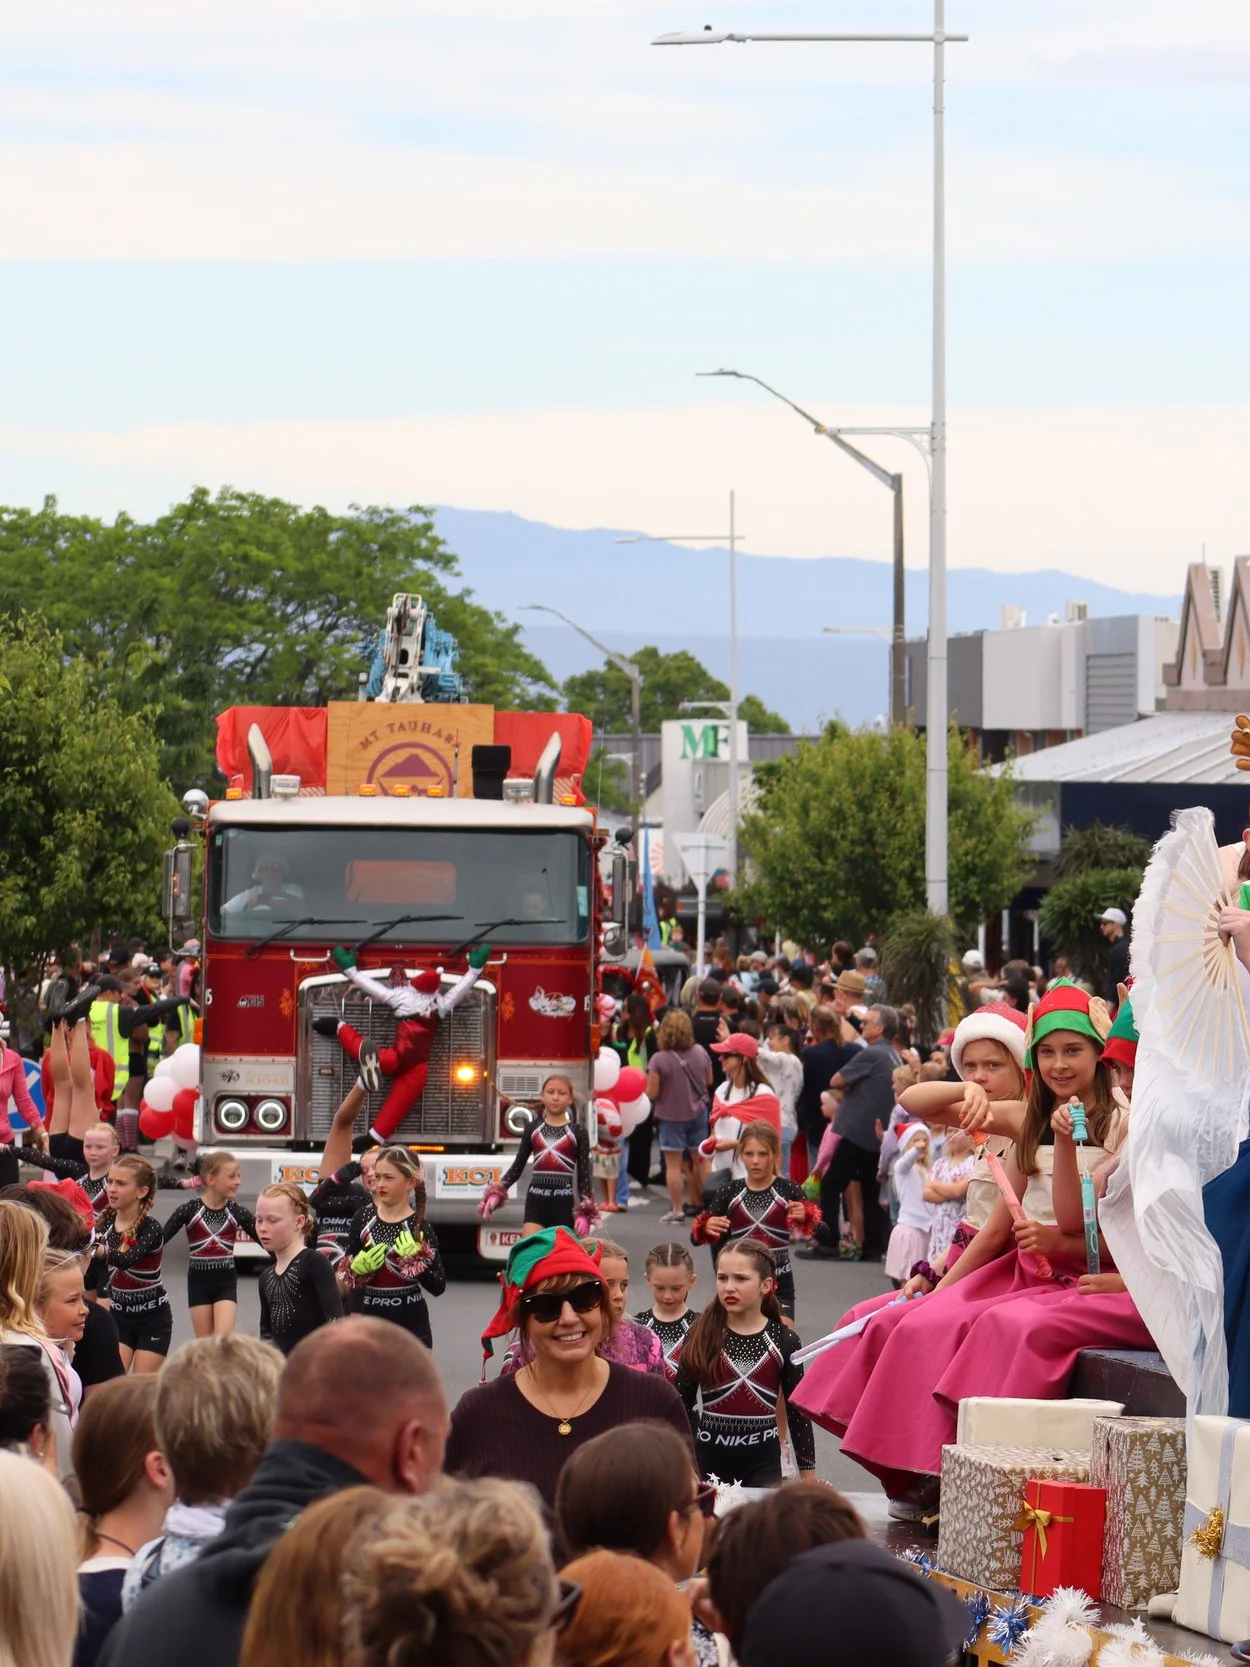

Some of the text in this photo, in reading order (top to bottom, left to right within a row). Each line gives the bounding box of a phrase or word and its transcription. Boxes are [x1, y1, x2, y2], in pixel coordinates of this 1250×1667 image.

[360, 730, 379, 750] MT
[529, 1186, 552, 1196] NIKE
[126, 1300, 157, 1313] NIKE
[372, 1297, 402, 1306] PRO
[714, 1431, 760, 1446] NIKE
